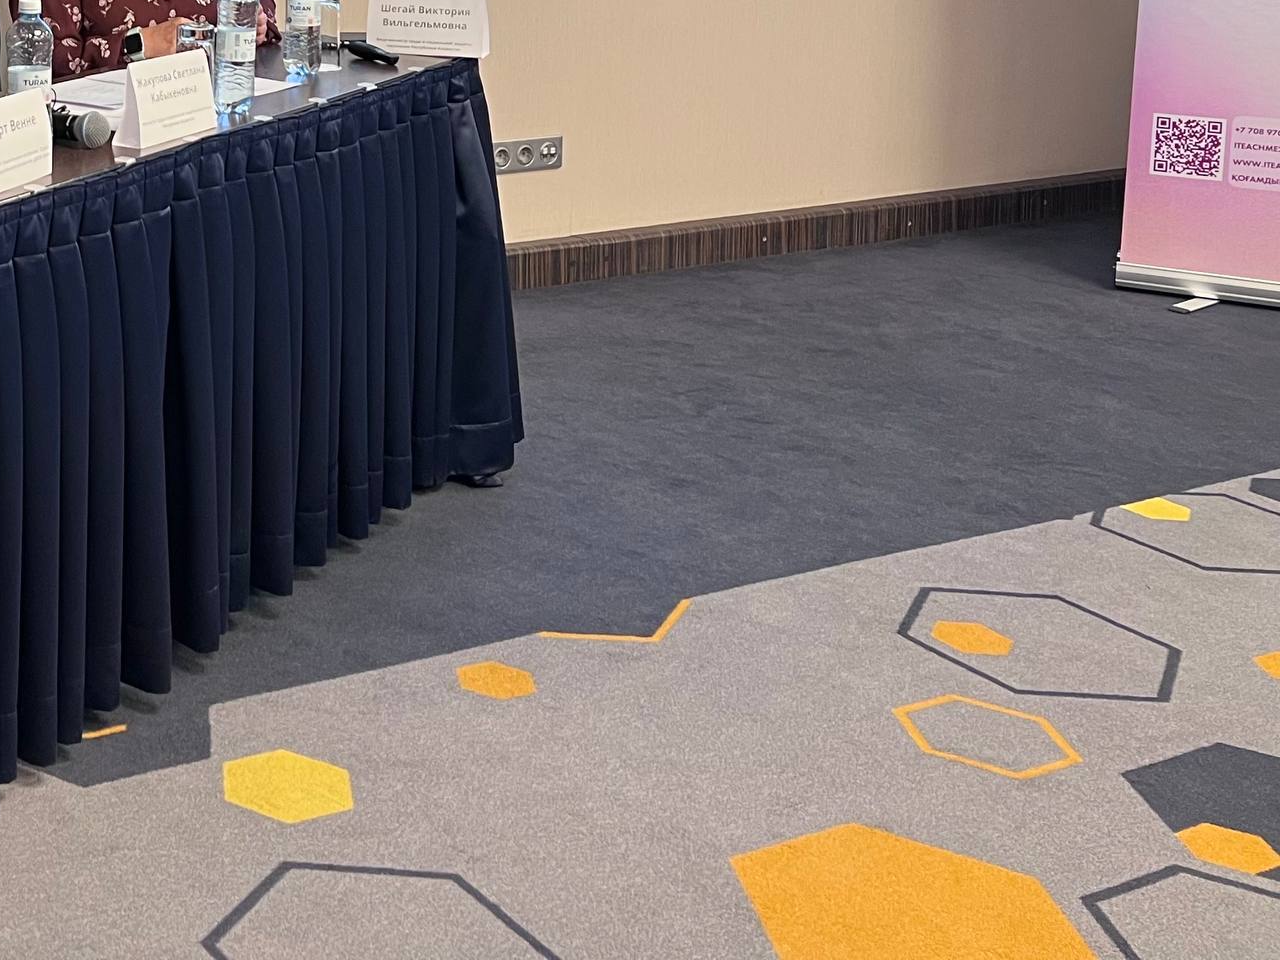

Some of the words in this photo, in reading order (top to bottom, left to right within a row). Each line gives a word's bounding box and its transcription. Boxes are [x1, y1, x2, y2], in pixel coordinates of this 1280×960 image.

[380, 3, 416, 14] Шегай
[418, 5, 471, 18] Виктория
[382, 17, 468, 30] Вильгельмовна
[1248, 127, 1265, 135] 708
[1234, 141, 1280, 153] ITEACHME
[1231, 174, 1280, 185] ҚОҒАМДЫ
